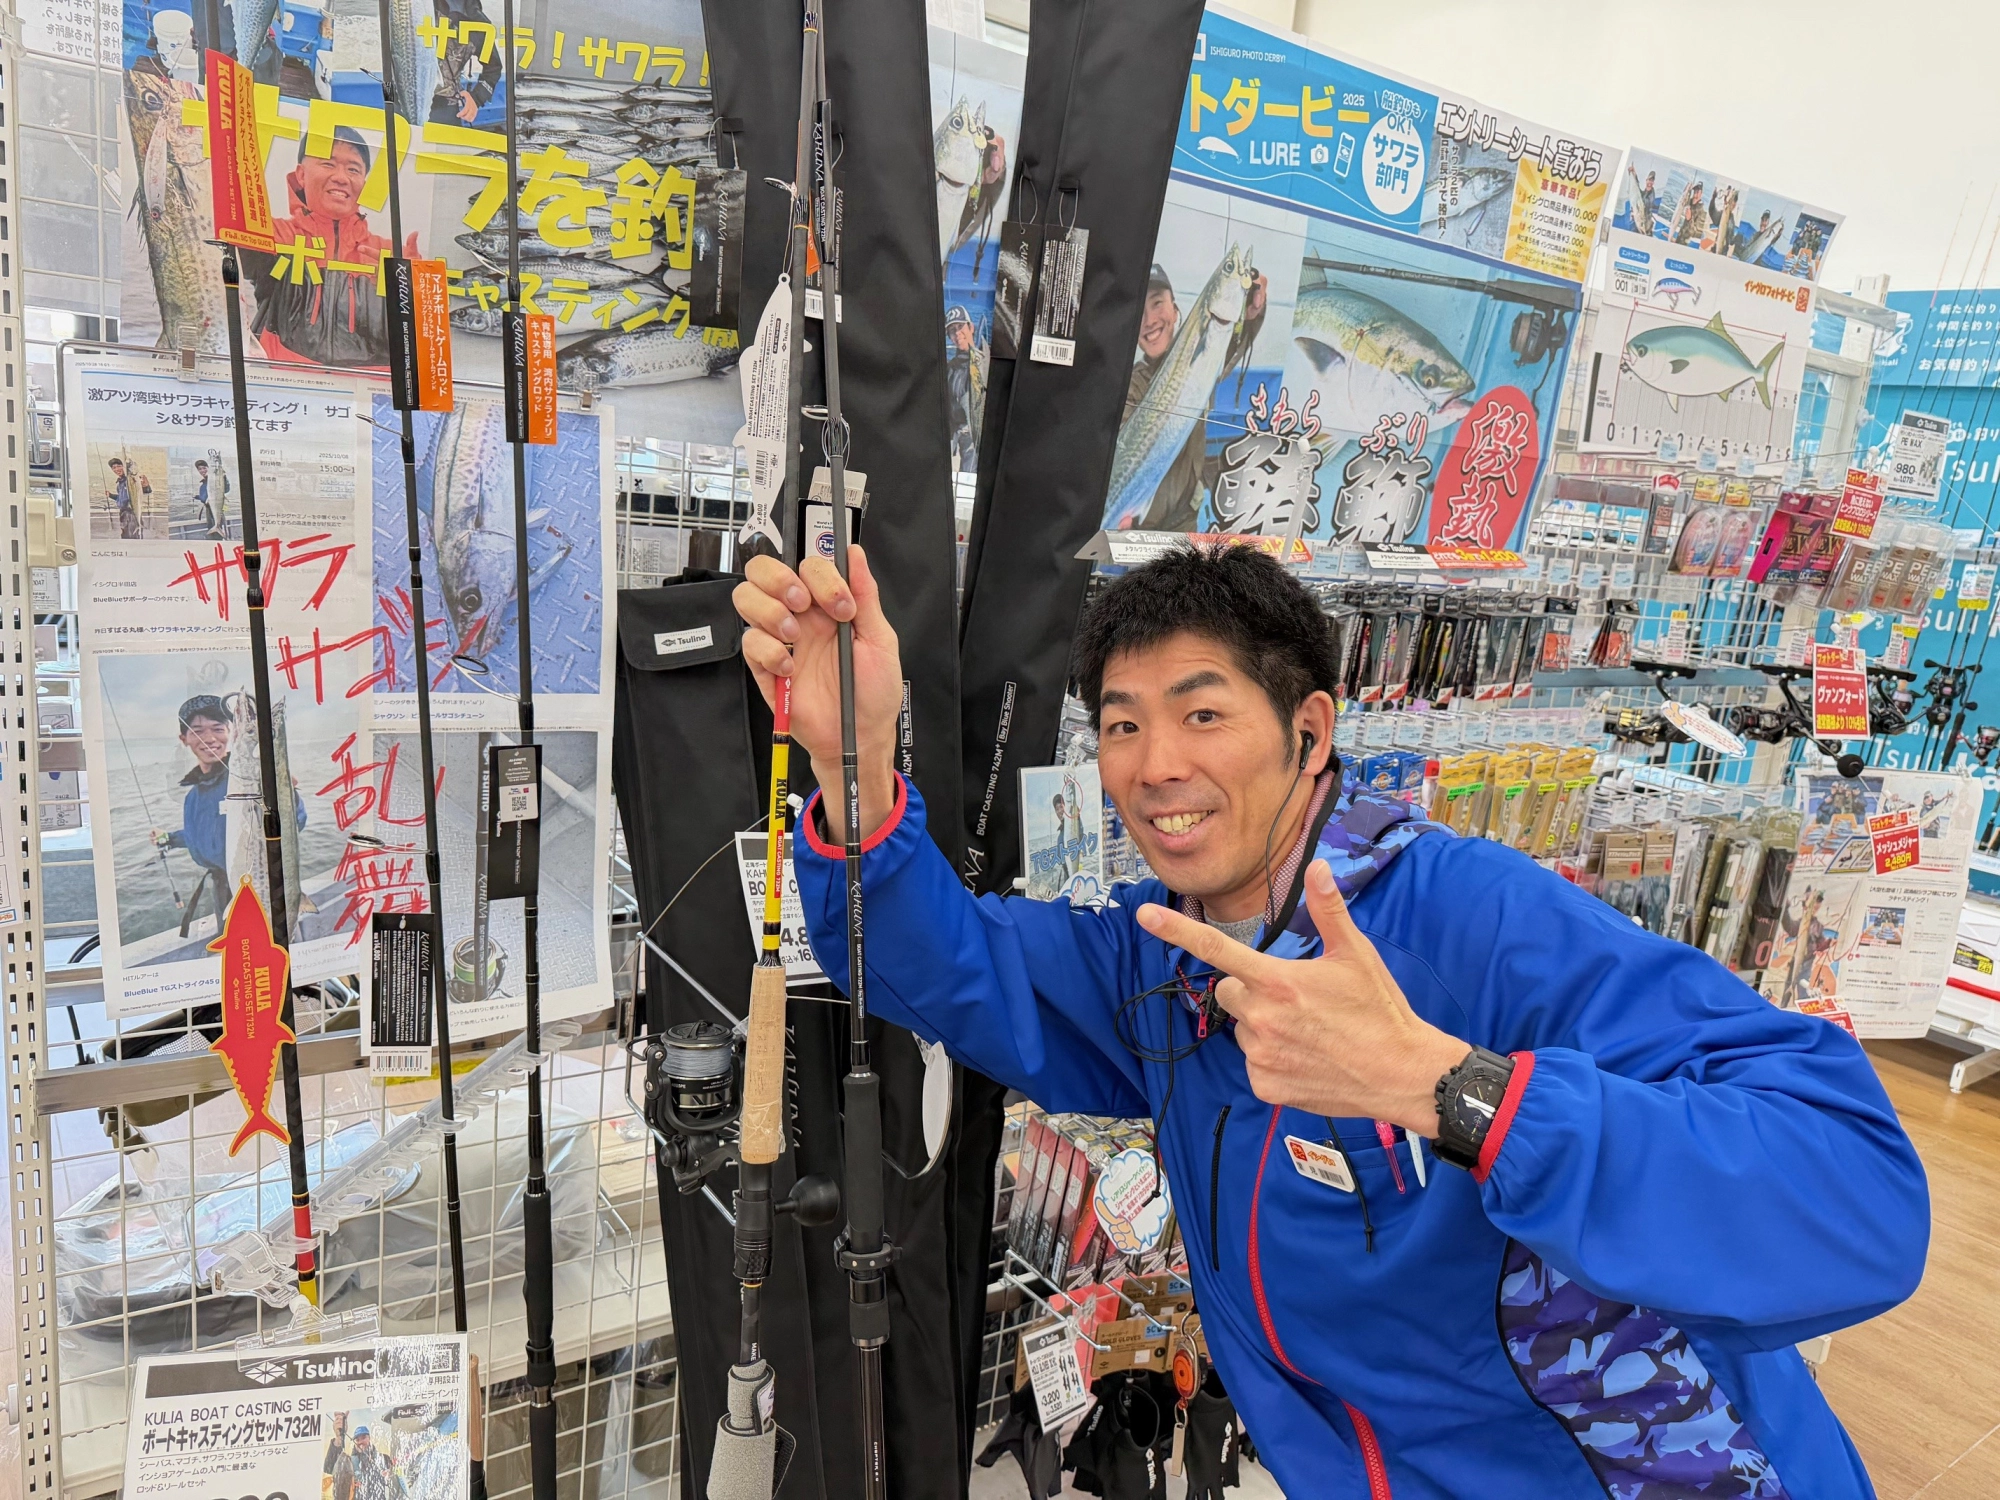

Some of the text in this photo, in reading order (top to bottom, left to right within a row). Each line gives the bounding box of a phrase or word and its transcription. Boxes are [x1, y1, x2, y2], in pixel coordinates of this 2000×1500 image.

[1210, 46, 1286, 63] ISHIGURO PHOTO DERBY!
[216, 59, 233, 130] KULIA
[1190, 74, 1370, 138] トダービー
[1342, 93, 1365, 106] 2025
[1380, 89, 1421, 118] 船釣りも
[812, 121, 824, 183] KAHUNA
[1249, 140, 1301, 166] LURE
[1373, 133, 1420, 170] サワラ
[1375, 162, 1409, 194] 部門
[714, 189, 729, 241] KAHUNA
[396, 263, 410, 315] KAHUNA
[1615, 279, 1628, 292] 001
[1940, 303, 2000, 315] 新たな釣り
[513, 315, 526, 367] KAHUNA
[530, 321, 542, 414] キャスティングロッド
[87, 387, 350, 419] 激アツ湾奥サワラキャティング！ サゴ
[1244, 382, 1323, 442] さわら
[156, 412, 293, 433] シ&サワラ釣てます
[1606, 422, 1615, 441] 0
[1632, 425, 1638, 444] 1
[1360, 411, 1428, 463] ぶり
[1721, 439, 1728, 457] 5
[1901, 437, 1909, 446] PE
[1765, 445, 1772, 462] 7
[1141, 532, 1174, 544] Tsulino
[166, 534, 355, 621] サワラ
[1910, 562, 1931, 576] PE
[676, 633, 707, 647] Tsulino
[782, 688, 790, 715] Tsulino
[1004, 684, 1015, 709] Shooter
[1818, 685, 1865, 705] ヴァンフォード
[901, 682, 911, 745] Bay Blue Shooter
[1002, 709, 1010, 726] Blue
[999, 726, 1008, 741] Bay
[774, 776, 787, 820] KULIA
[982, 773, 999, 811] CASTING
[849, 794, 858, 829] Tsulino
[976, 812, 989, 836] BOAT
[1029, 832, 1098, 874] TGストライク
[478, 872, 489, 920] KAHUNA
[852, 879, 866, 937] KAHUNA
[420, 931, 430, 972] KAHUNA
[122, 972, 159, 982] HITルアーは
[241, 938, 255, 1039] BOAT CASTING SET 732M
[254, 965, 272, 1013] KULIA
[124, 987, 158, 998] BlueBlue
[1474, 1067, 1485, 1075] 25
[292, 1358, 376, 1382] Tsulino
[144, 1397, 323, 1426] KULIA BOAT CASTING SET
[142, 1414, 322, 1454] ボートキャスティングセット732M
[138, 1462, 256, 1482] インショアゲームの入門に最適な
[136, 1479, 206, 1494] ロッド&リールセット
